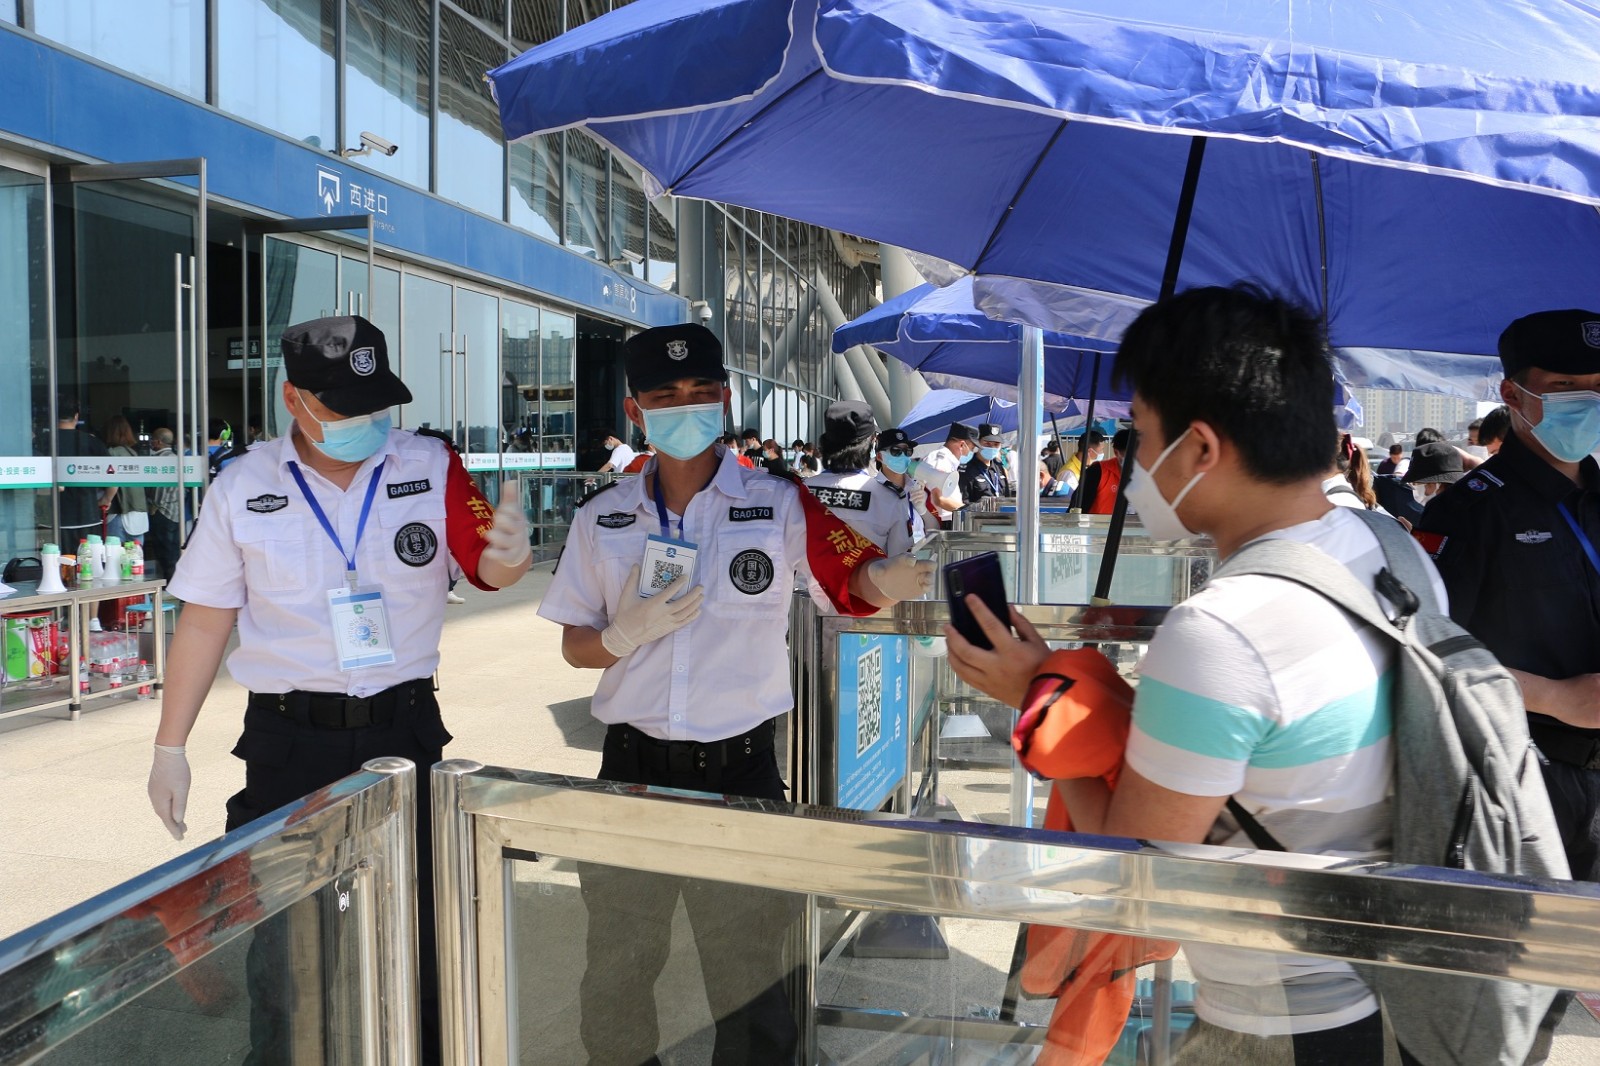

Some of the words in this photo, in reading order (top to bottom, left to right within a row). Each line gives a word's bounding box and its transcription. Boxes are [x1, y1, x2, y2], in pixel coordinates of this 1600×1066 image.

[349, 183, 388, 215] 西进口
[630, 287, 637, 313] 8
[389, 481, 428, 497] GA0156
[732, 508, 770, 519] GA0170
